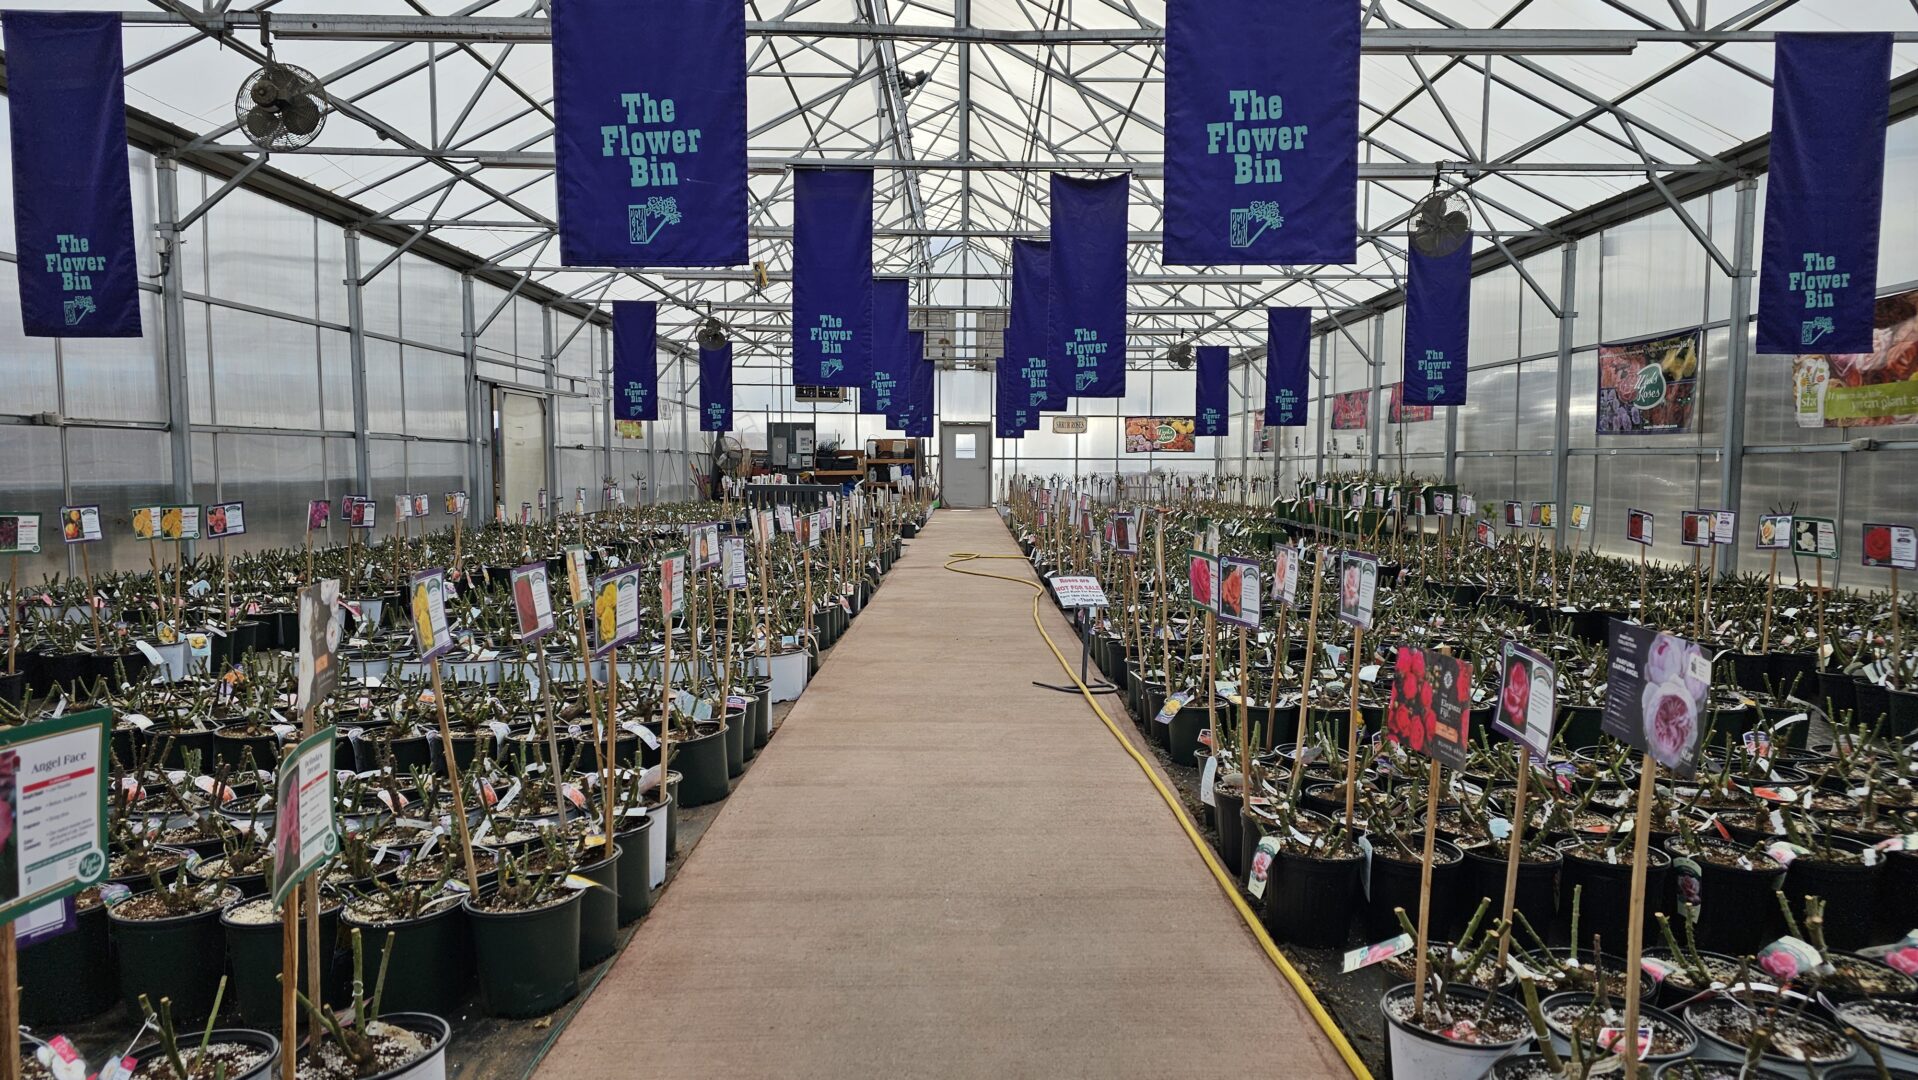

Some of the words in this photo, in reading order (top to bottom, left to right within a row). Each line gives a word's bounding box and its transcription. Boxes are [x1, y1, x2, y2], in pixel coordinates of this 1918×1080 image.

[621, 92, 675, 124] The
[1229, 90, 1283, 121] The
[601, 125, 701, 157] Flower
[1207, 122, 1308, 154] Flower
[629, 155, 678, 187] Bin
[1234, 153, 1283, 184] Bin
[56, 234, 89, 253] The
[45, 254, 106, 272] Flower
[1803, 253, 1836, 271] The
[62, 272, 92, 290] Bin
[1789, 272, 1850, 290] Flower
[1805, 290, 1834, 308] Bin
[820, 315, 842, 328] The
[811, 328, 853, 340] Flower
[1074, 328, 1097, 341] The
[822, 341, 842, 353] Bin
[1065, 342, 1108, 355] Flower
[1077, 354, 1097, 367] Bin
[1426, 350, 1443, 360] The
[1029, 358, 1046, 368] The
[1418, 360, 1451, 370] Flower
[875, 371, 890, 380] The
[1427, 370, 1443, 379] Bin
[629, 381, 642, 389] The
[1030, 378, 1046, 388] Bin
[1637, 389, 1660, 402] Roses
[1881, 395, 1908, 410] plant
[31, 755, 61, 774] Angel
[64, 751, 87, 765] Face
